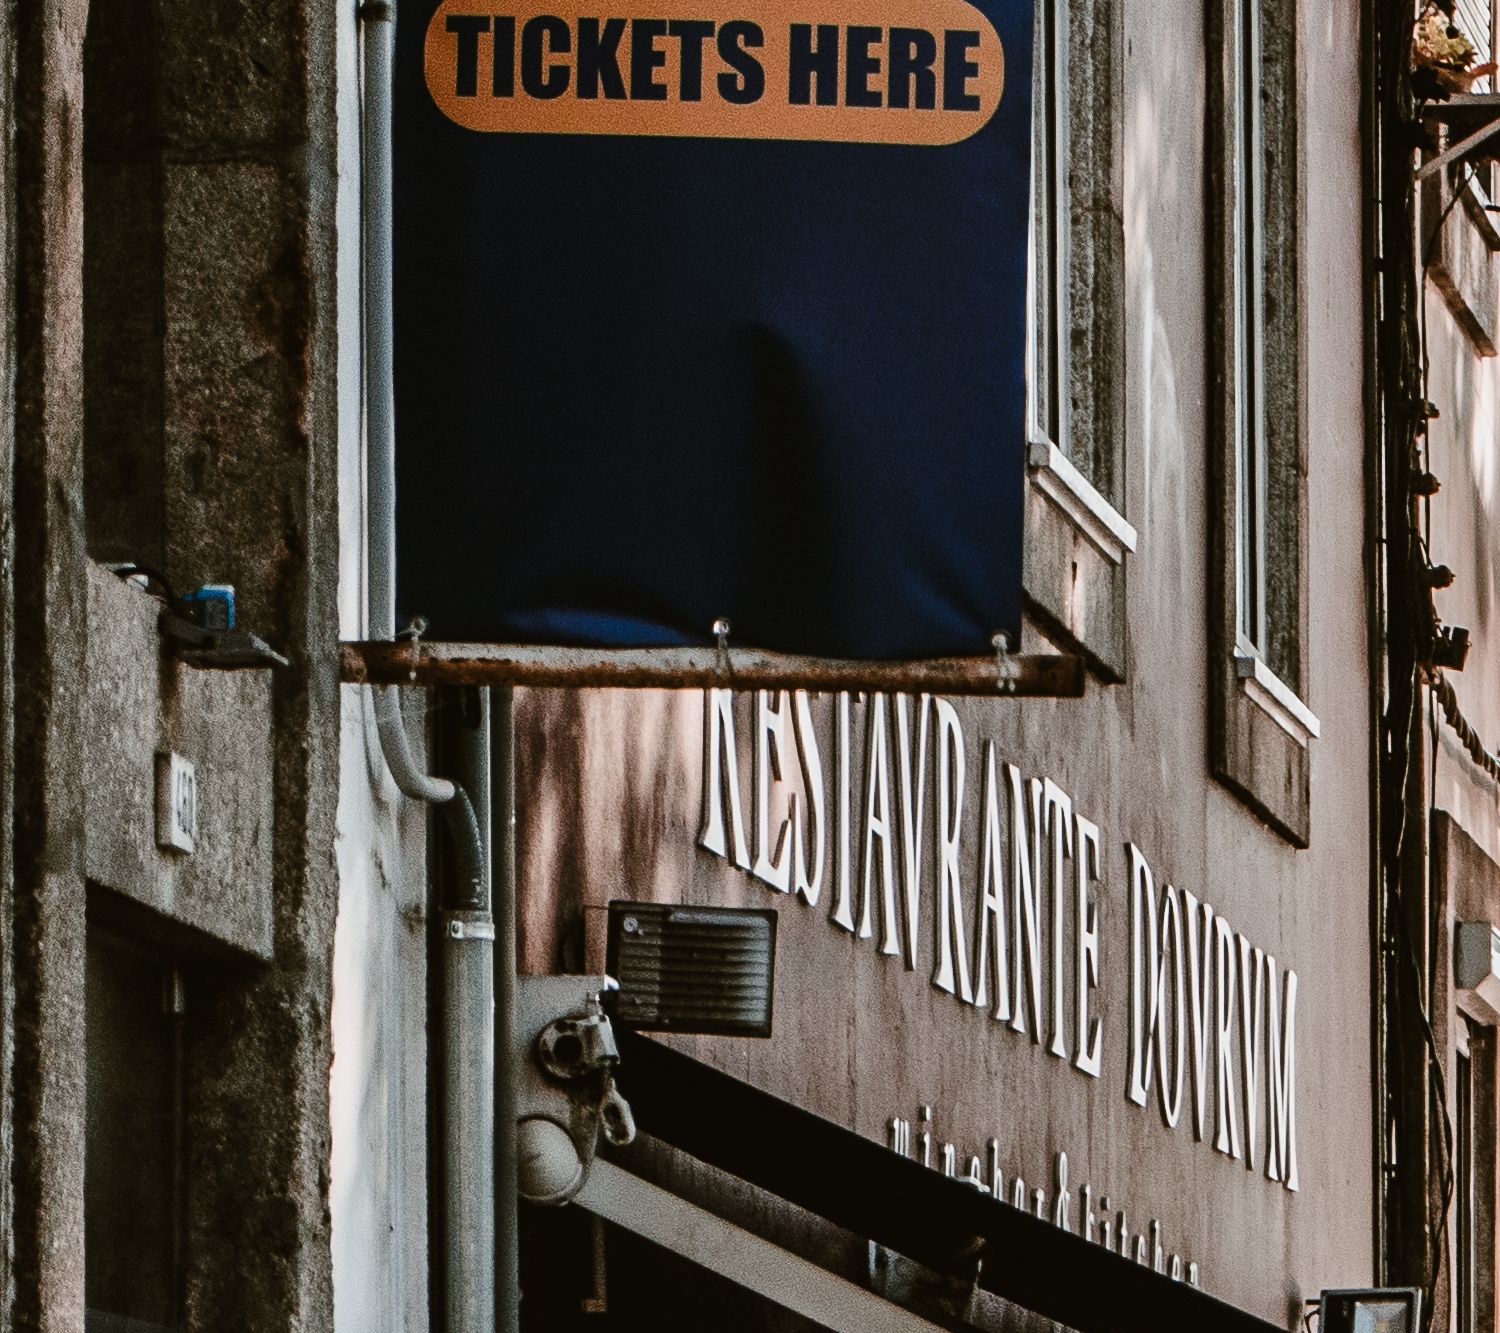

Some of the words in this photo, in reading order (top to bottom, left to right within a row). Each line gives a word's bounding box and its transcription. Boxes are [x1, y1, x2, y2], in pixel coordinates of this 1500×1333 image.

[446, 15, 765, 104] TICKETS
[788, 23, 980, 111] HERE
[1125, 842, 1299, 1192] DOVRVM
